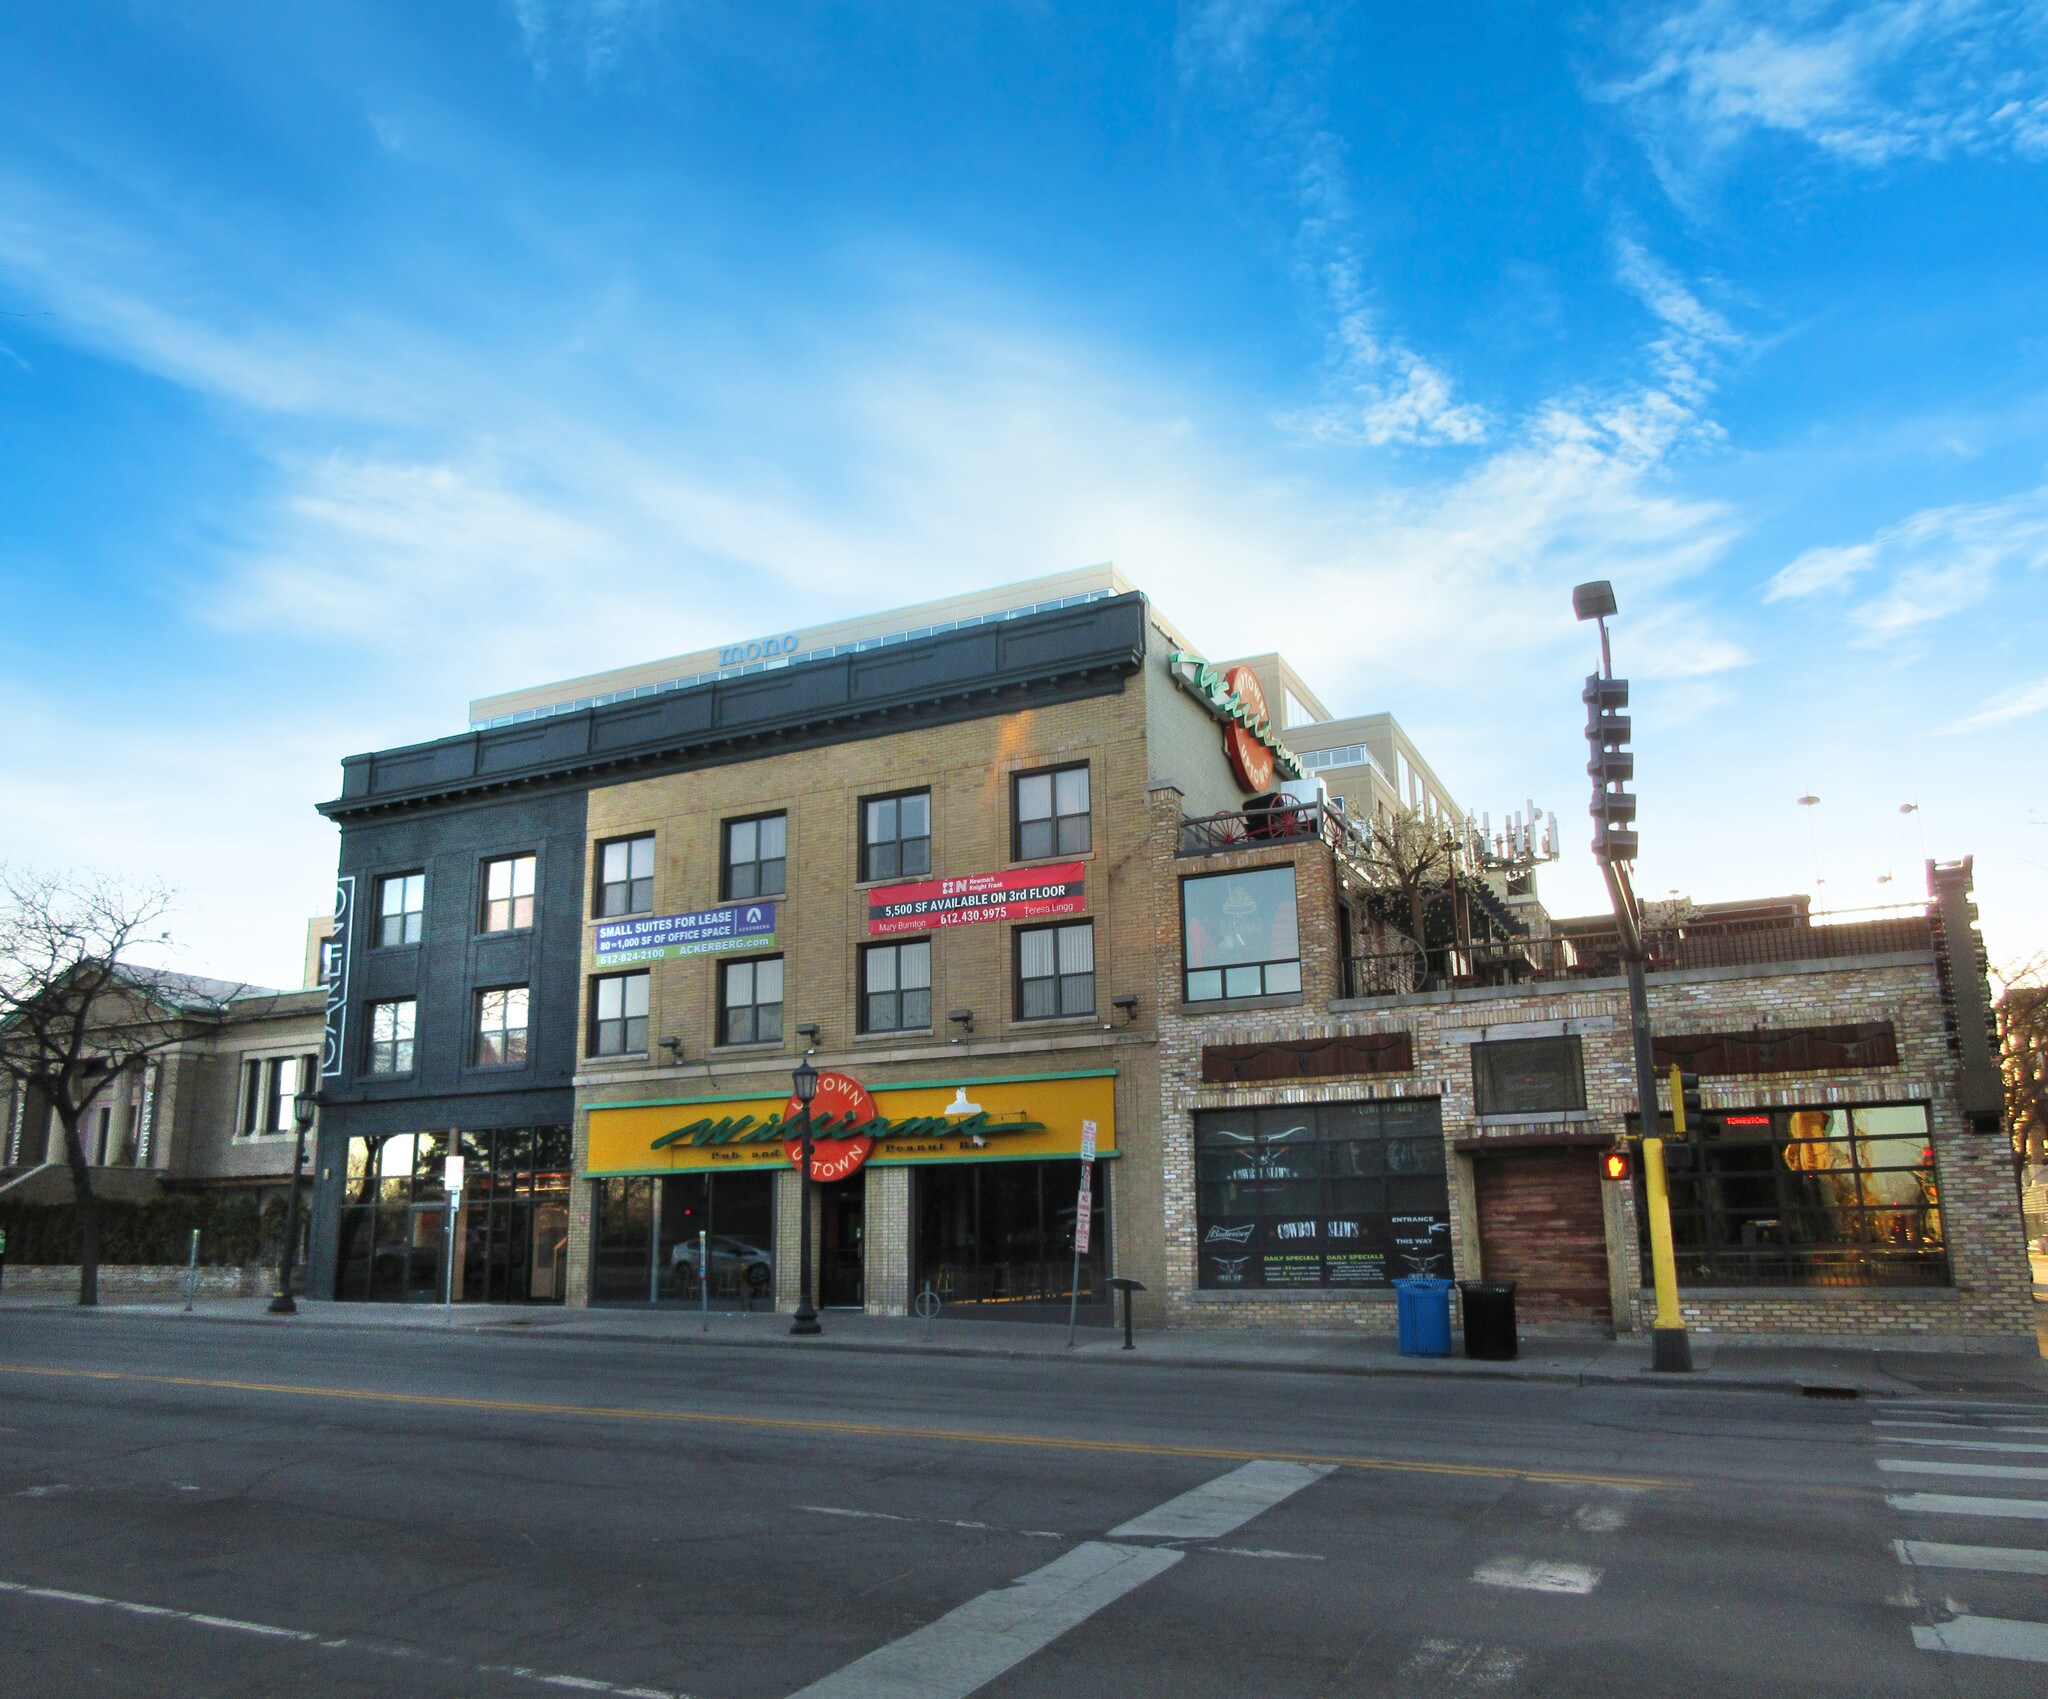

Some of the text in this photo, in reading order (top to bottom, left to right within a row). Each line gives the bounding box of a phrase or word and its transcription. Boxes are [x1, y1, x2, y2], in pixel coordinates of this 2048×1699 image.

[719, 633, 799, 666] mono
[1241, 744, 1269, 784] UPTOWN
[969, 876, 995, 885] Newmark
[969, 884, 987, 892] Knight
[885, 885, 1066, 917] 5,500 SF AVAILABLE ON 3rd FLOOR
[1024, 903, 1074, 915] Teresa Lingg
[600, 911, 732, 938] SMALL SUITES FOR LEASE
[738, 924, 770, 932] ACKERBERG
[879, 923, 897, 932] Mary
[940, 907, 1007, 925] 612.430.9975
[617, 937, 640, 950] 1,000
[641, 936, 652, 946] SF
[653, 934, 666, 944] OF
[668, 929, 699, 942] OFFICE
[701, 926, 731, 938] SPACE
[600, 938, 769, 965] 612-824-2100 ACKERBERG.com
[792, 1078, 863, 1110] UTOWN
[140, 1091, 154, 1157] MANSION
[650, 1111, 1047, 1150] Williams
[751, 1150, 783, 1159] and
[792, 1144, 863, 1176] UTOWN
[1277, 1221, 1359, 1239] COWBOY SLIM'S
